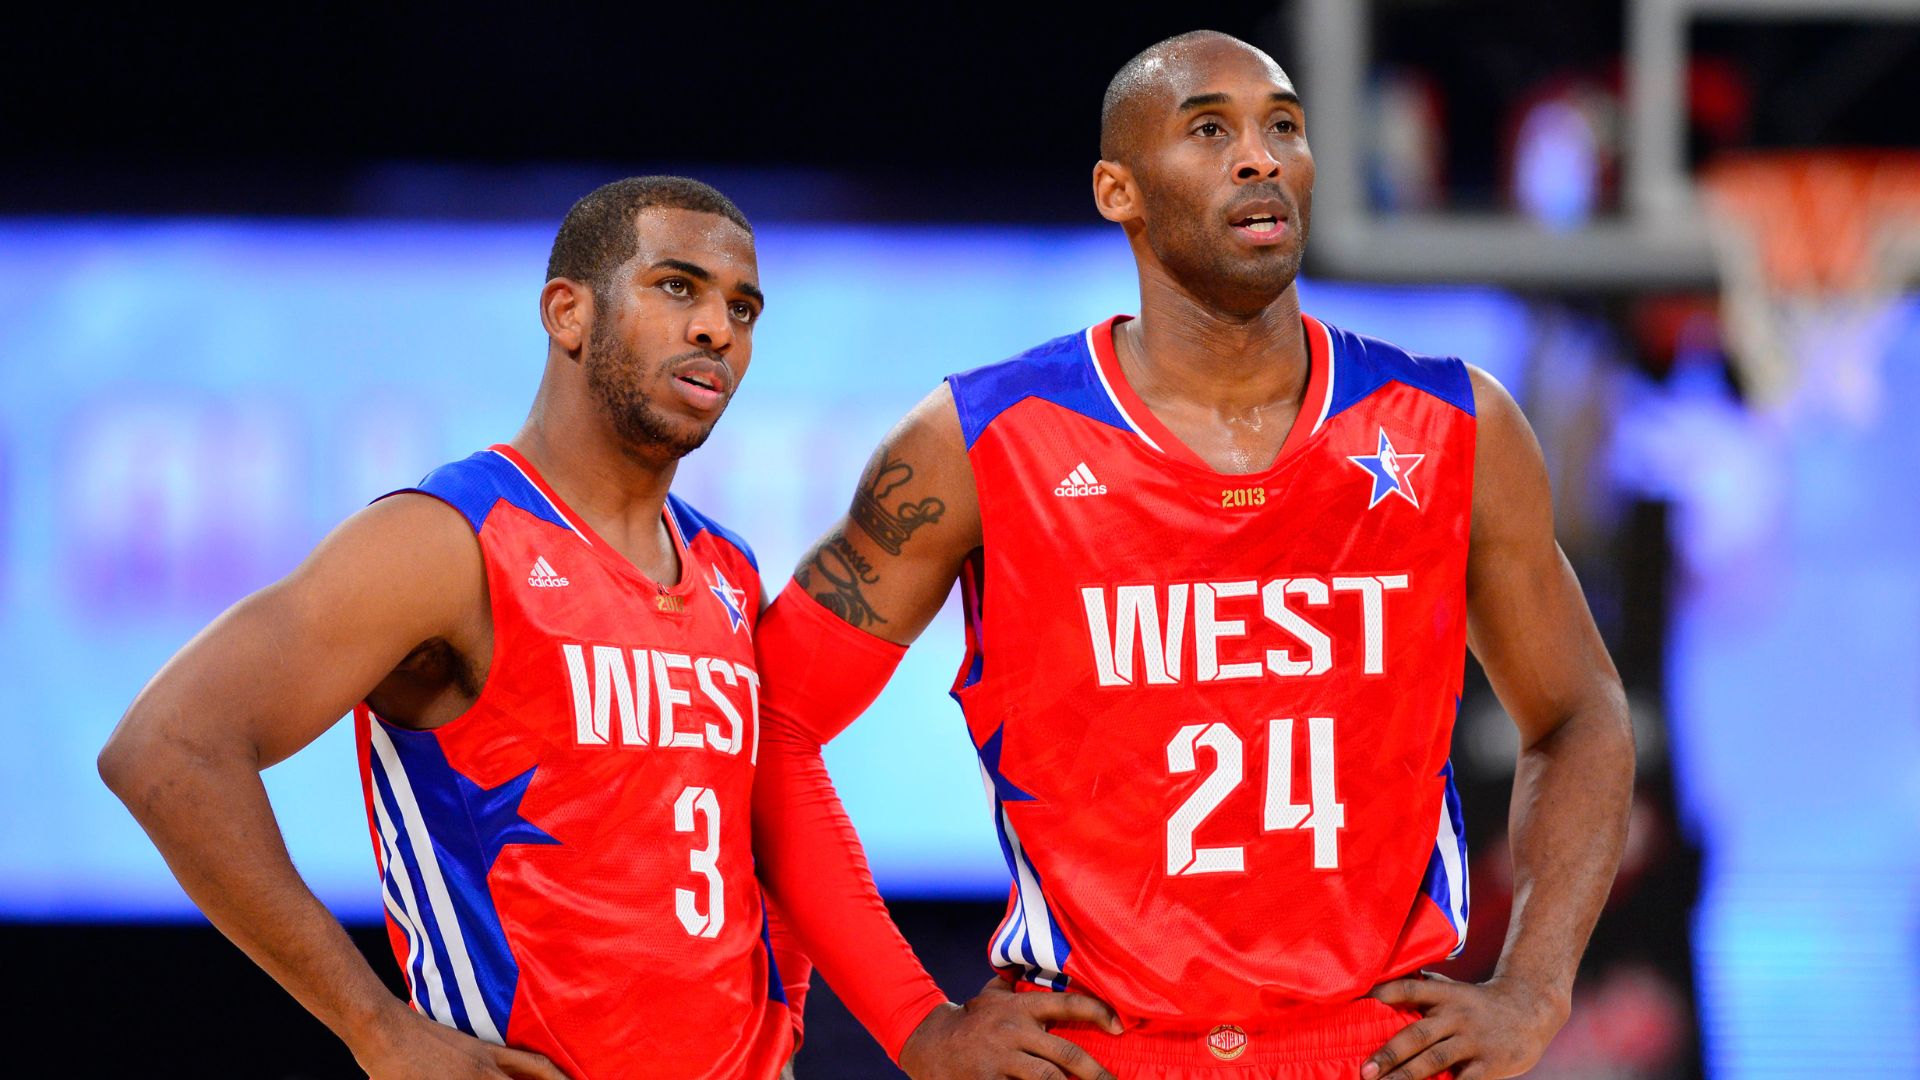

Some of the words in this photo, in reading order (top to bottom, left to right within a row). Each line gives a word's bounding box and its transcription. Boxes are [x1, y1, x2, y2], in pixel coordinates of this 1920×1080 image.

[1054, 484, 1107, 497] adidas
[1221, 487, 1266, 508] 2013
[527, 575, 570, 588] adidas
[1081, 574, 1409, 686] WEST
[562, 644, 760, 766] WEST
[1166, 717, 1345, 876] 24
[674, 786, 725, 938] 3
[1210, 1029, 1245, 1051] WESTERN
